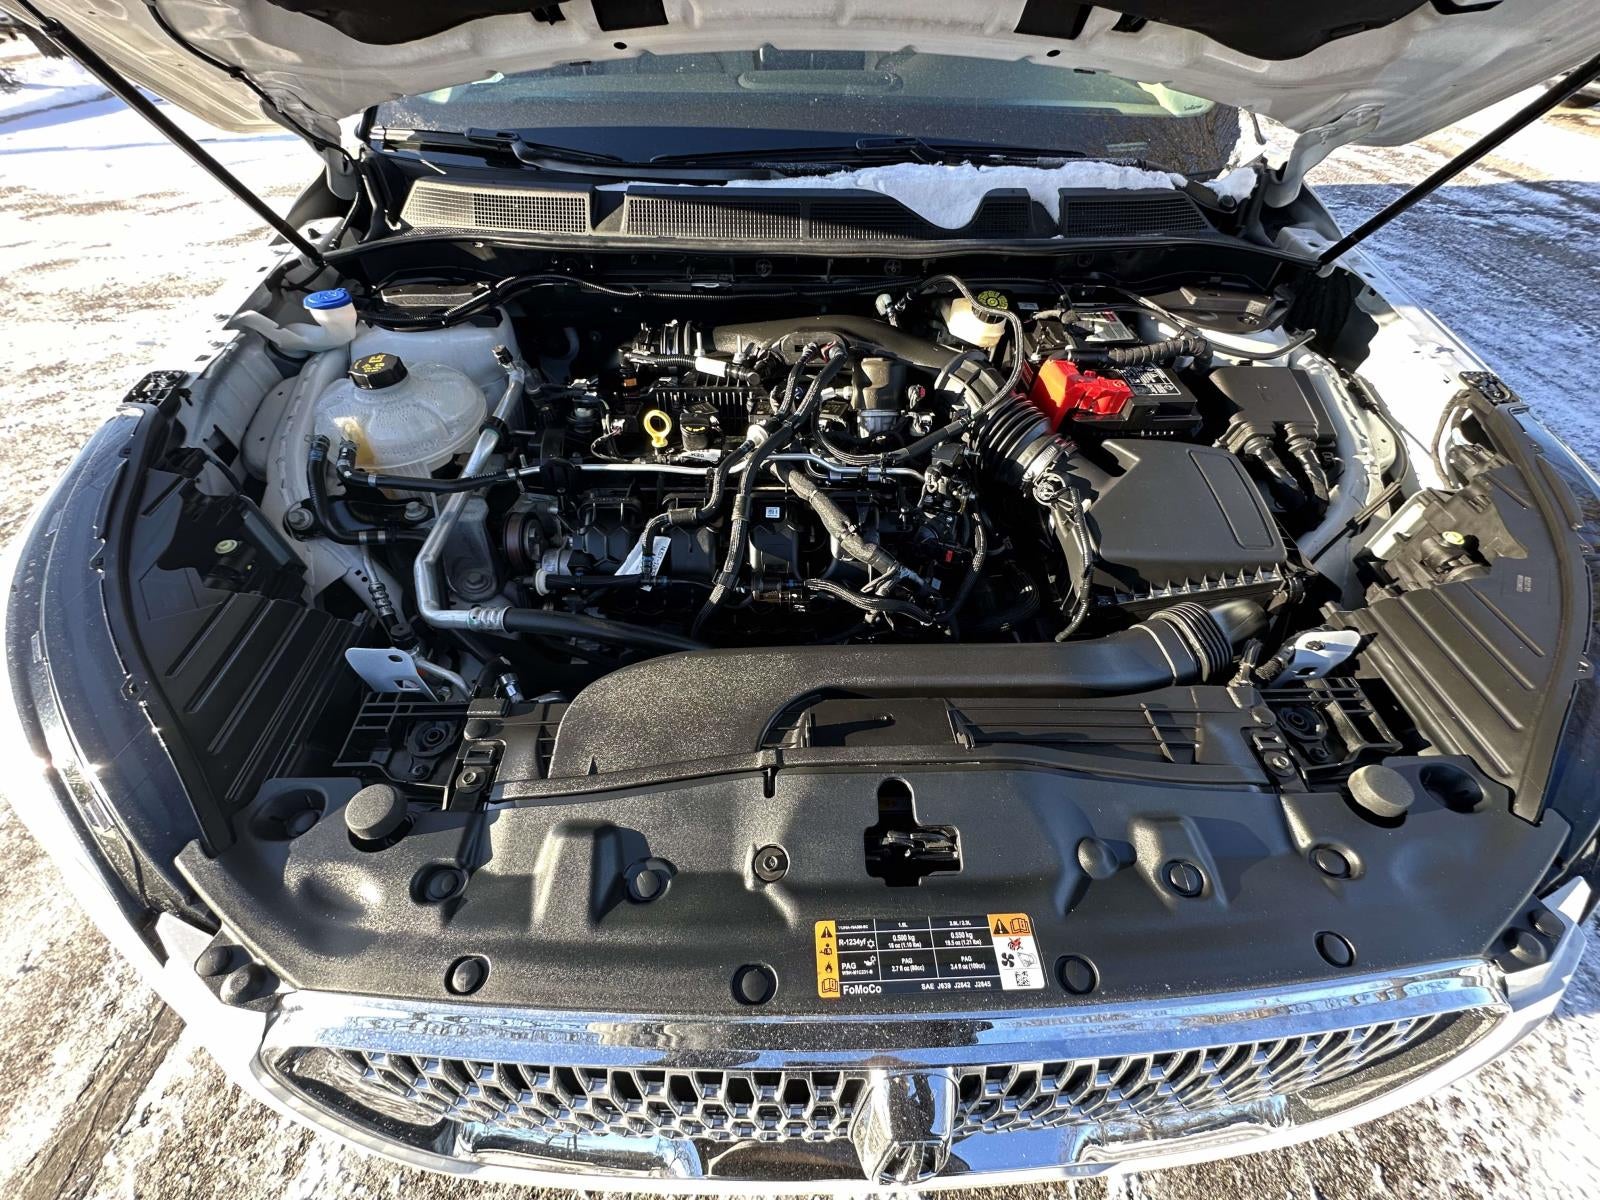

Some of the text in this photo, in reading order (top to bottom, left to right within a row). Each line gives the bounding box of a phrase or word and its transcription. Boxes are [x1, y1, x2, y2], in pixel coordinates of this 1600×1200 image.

[908, 933, 916, 942] kg
[965, 931, 973, 940] kg
[838, 938, 866, 947] R-1234yf
[841, 962, 857, 970] PAG
[842, 984, 882, 995] FoMoCo
